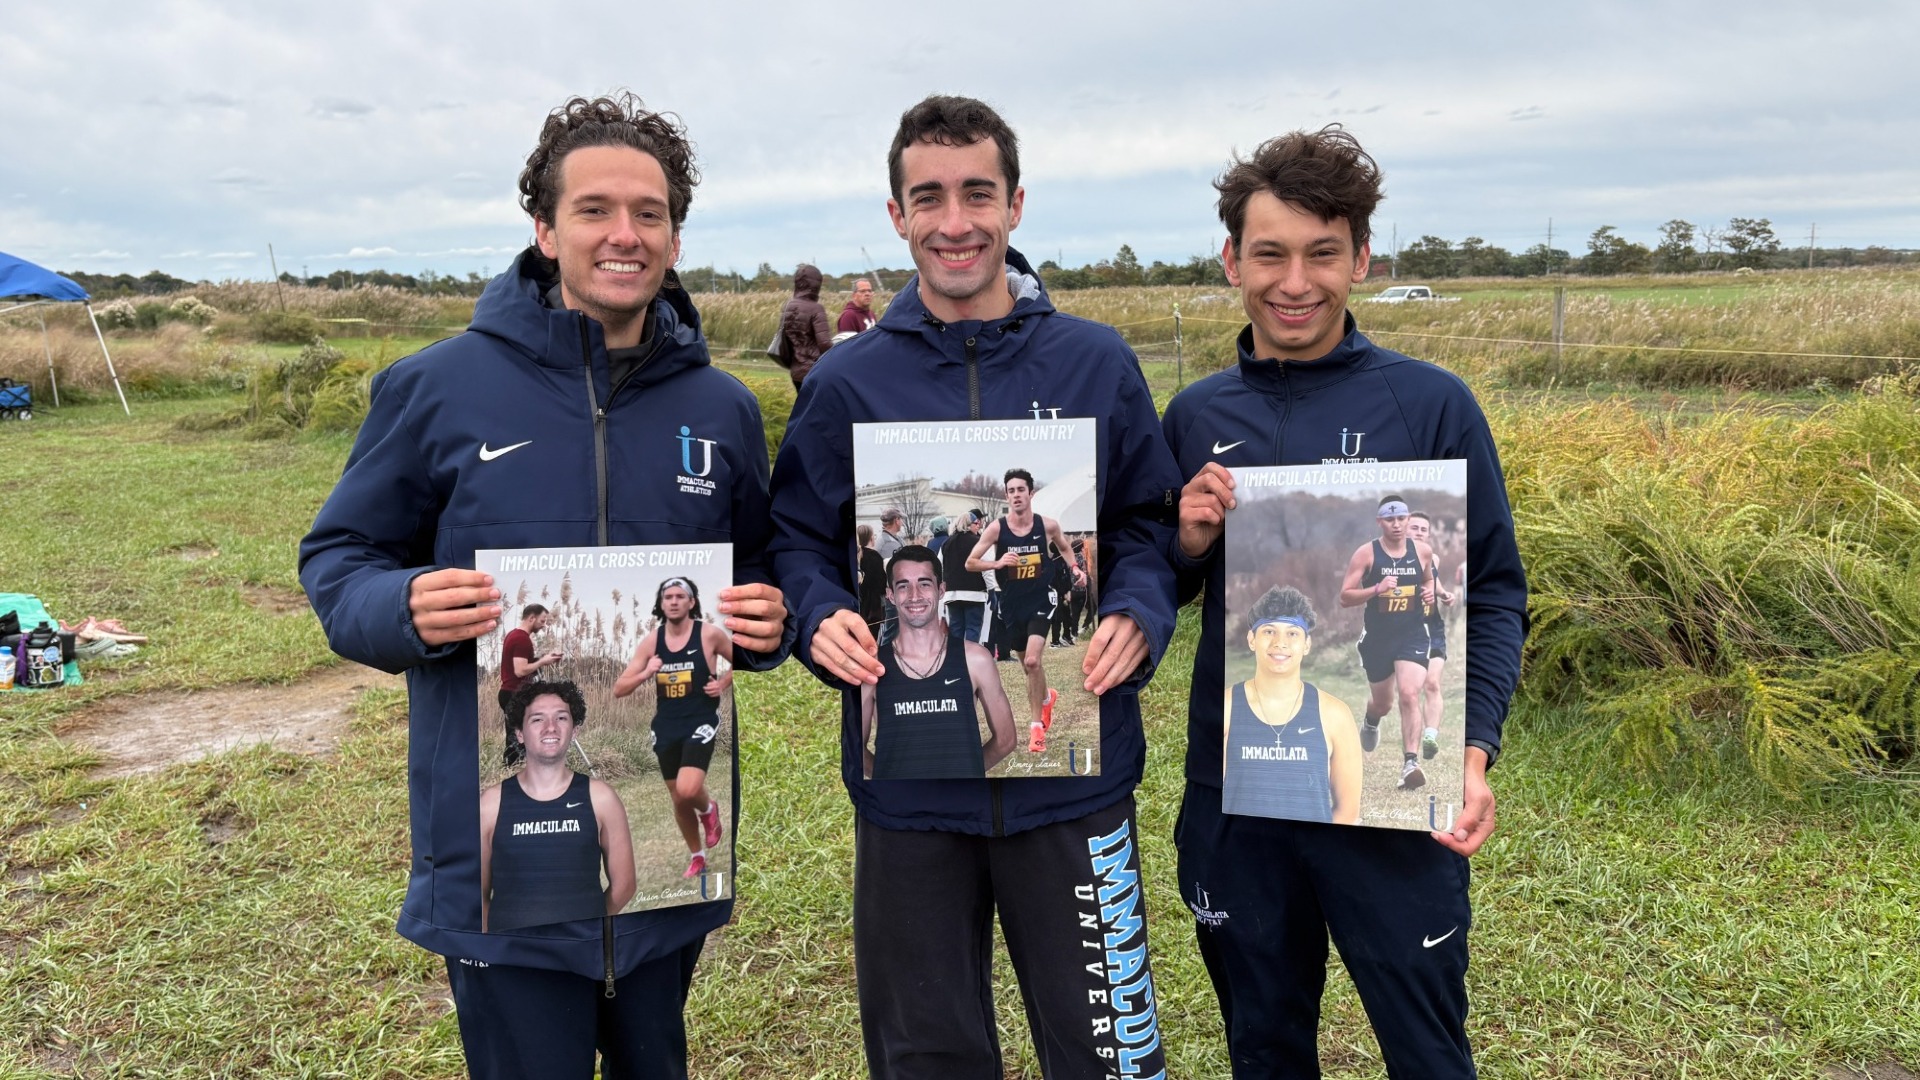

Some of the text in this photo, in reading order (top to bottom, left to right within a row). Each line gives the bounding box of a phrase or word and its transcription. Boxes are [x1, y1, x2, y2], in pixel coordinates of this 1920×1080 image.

[875, 423, 1076, 444] IMMACULATA CROSS COUNTRY
[677, 475, 716, 489] IMMACULATA
[1244, 465, 1445, 487] IMMACULATA CROSS COUNTRY
[680, 484, 712, 496] ATHLETICS
[1007, 545, 1039, 554] IMMACULATA
[500, 549, 713, 572] IMMACULATA CROSS COUNTRY
[1016, 565, 1036, 579] 172
[1381, 567, 1417, 576] IMMACULATA
[1387, 598, 1408, 612] 173
[665, 683, 686, 698] 169
[894, 698, 958, 716] IMMACULATA
[1241, 746, 1308, 761] IMMACULATA
[512, 819, 580, 836] IMMACULATA
[1088, 818, 1167, 1080] IMMACUL
